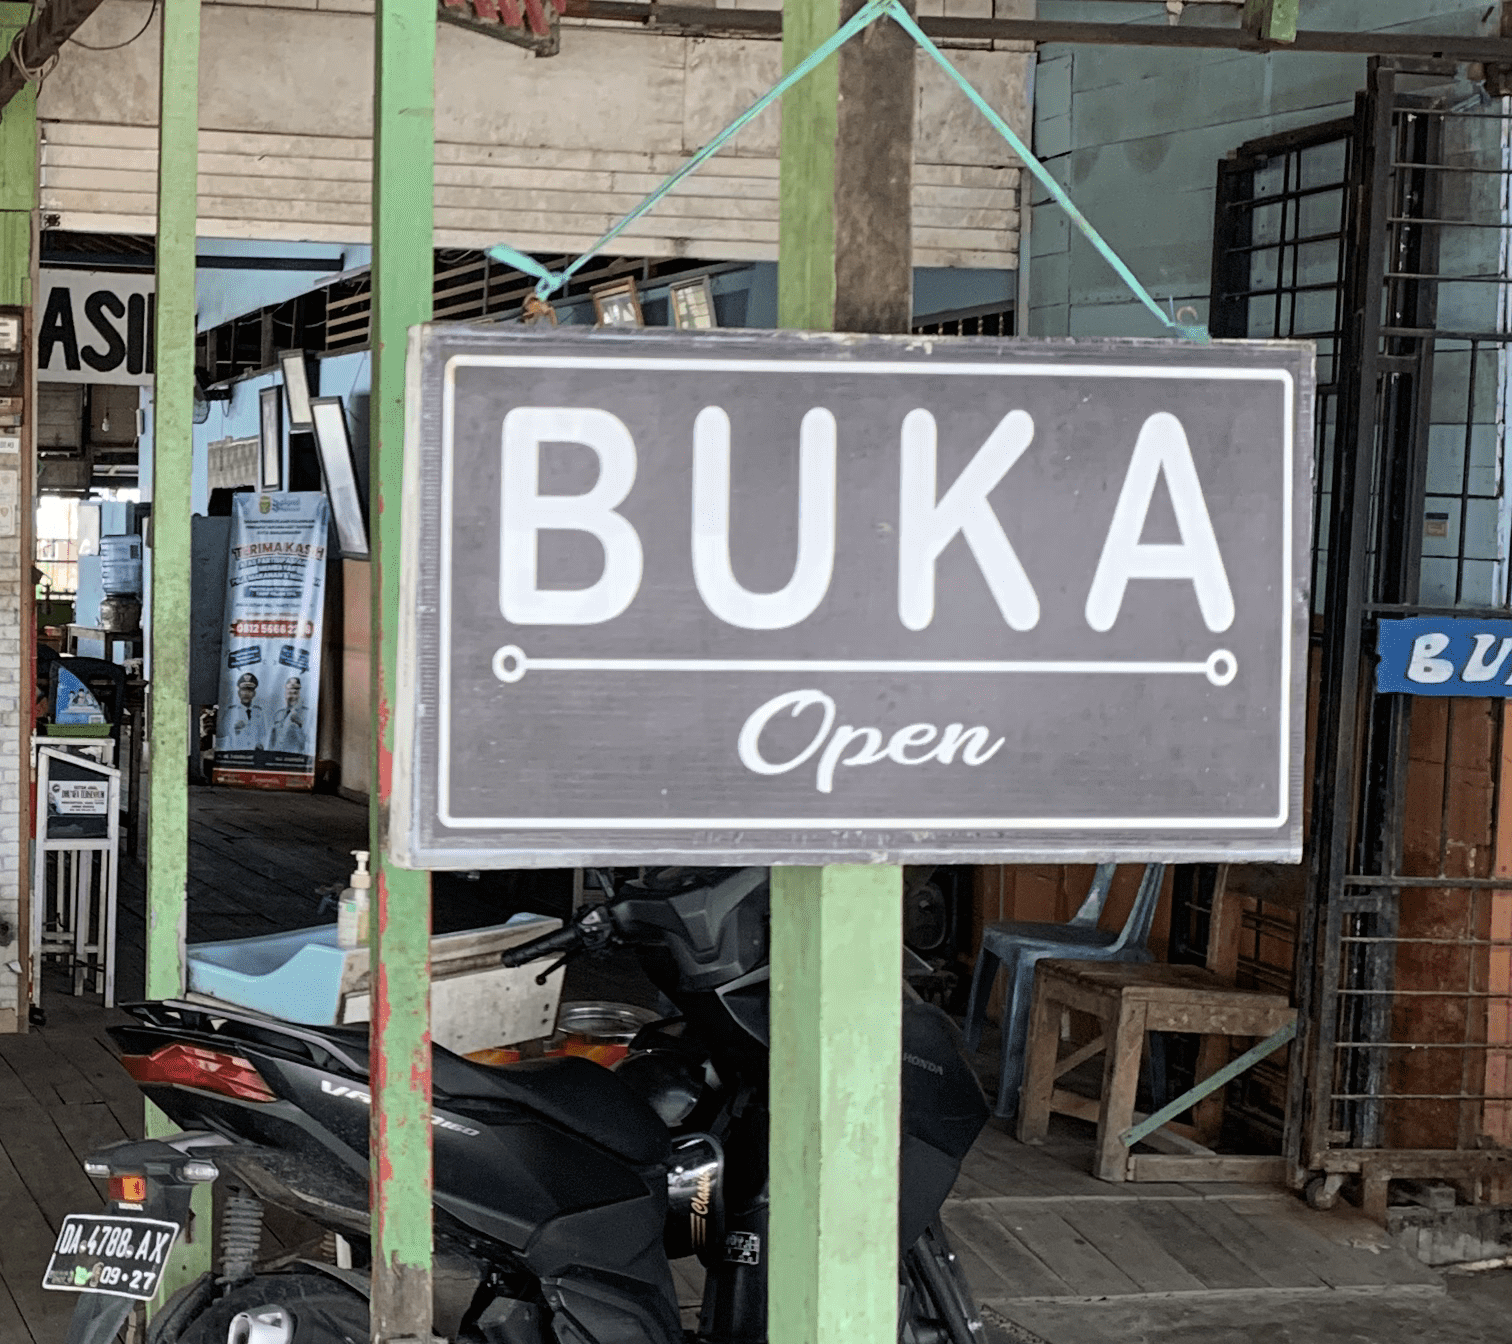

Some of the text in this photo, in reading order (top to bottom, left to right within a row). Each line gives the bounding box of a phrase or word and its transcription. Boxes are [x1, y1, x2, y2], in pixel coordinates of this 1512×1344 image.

[499, 405, 1235, 632] BUKA
[285, 542, 325, 562] KASH
[1407, 632, 1512, 686] BU
[737, 689, 1006, 793] Open
[58, 1223, 171, 1264] DA 4788 AX
